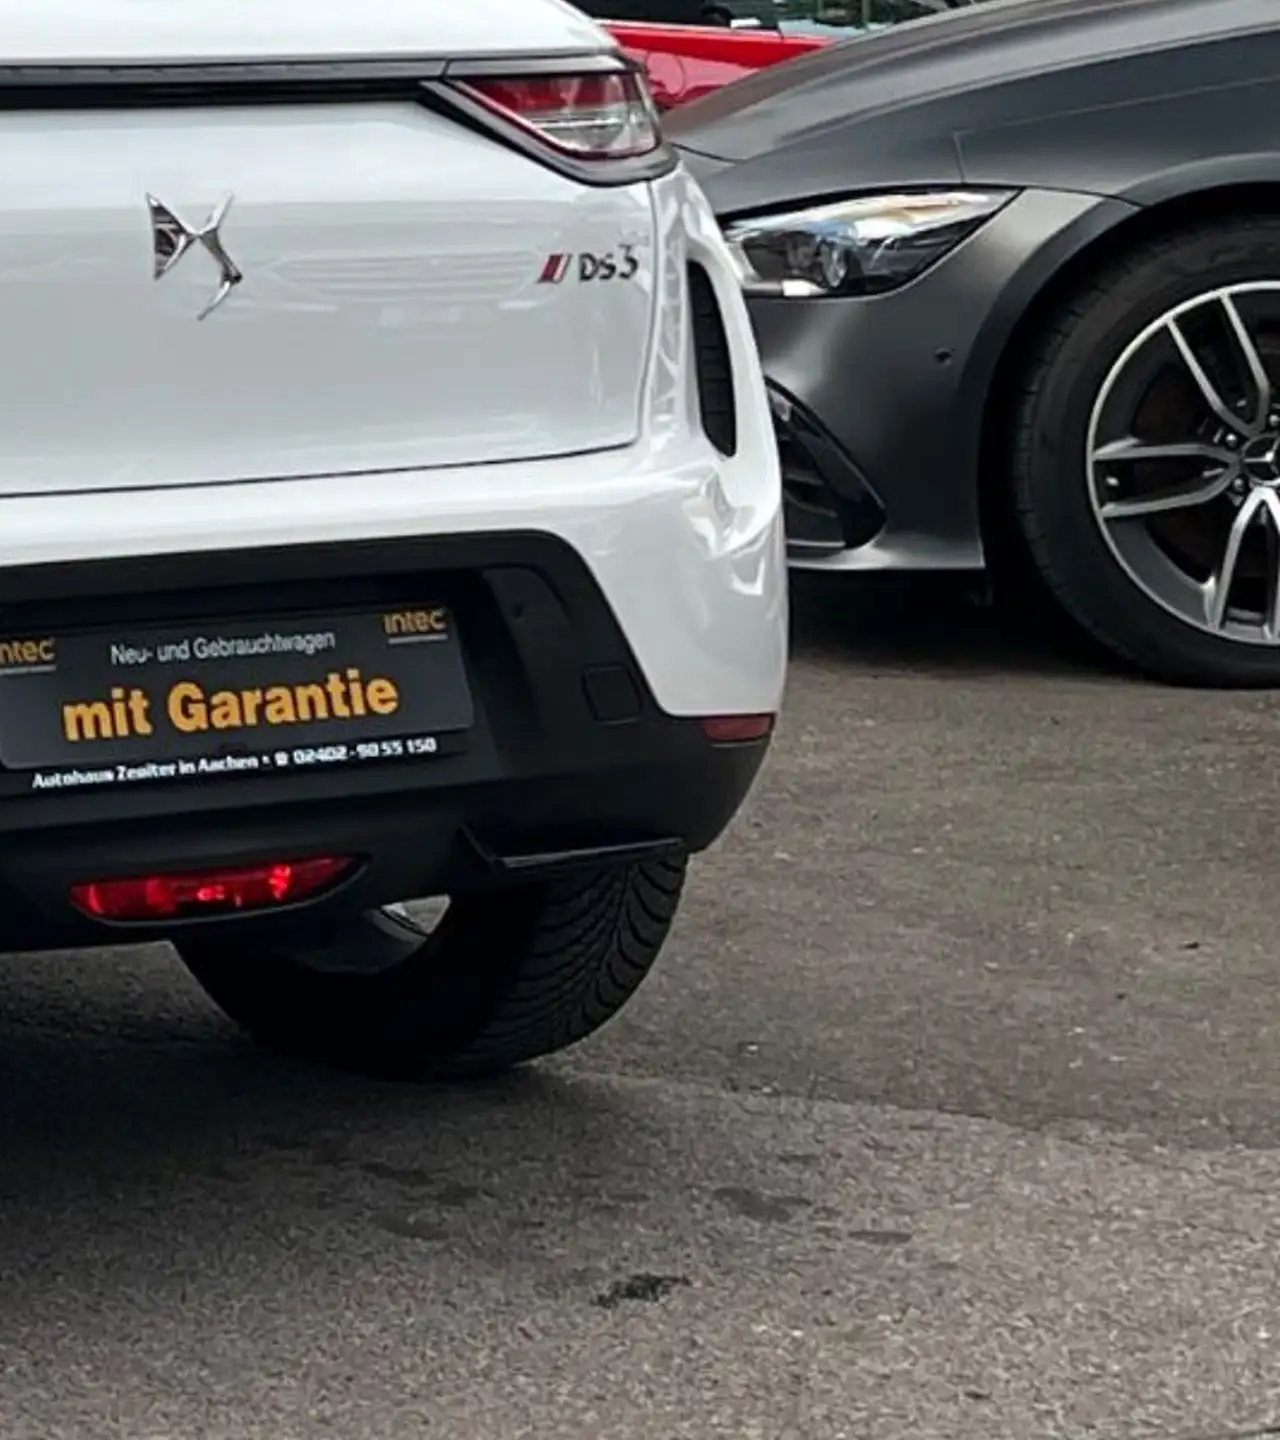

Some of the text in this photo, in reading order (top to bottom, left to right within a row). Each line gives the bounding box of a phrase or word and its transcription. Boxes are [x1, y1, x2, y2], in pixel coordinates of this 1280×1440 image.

[111, 631, 336, 665] Neu- und Gebrauchtwagen
[61, 669, 398, 741] mit Garantie
[32, 769, 114, 789] Autohaus
[179, 760, 197, 775] in
[197, 754, 258, 772] Aachen
